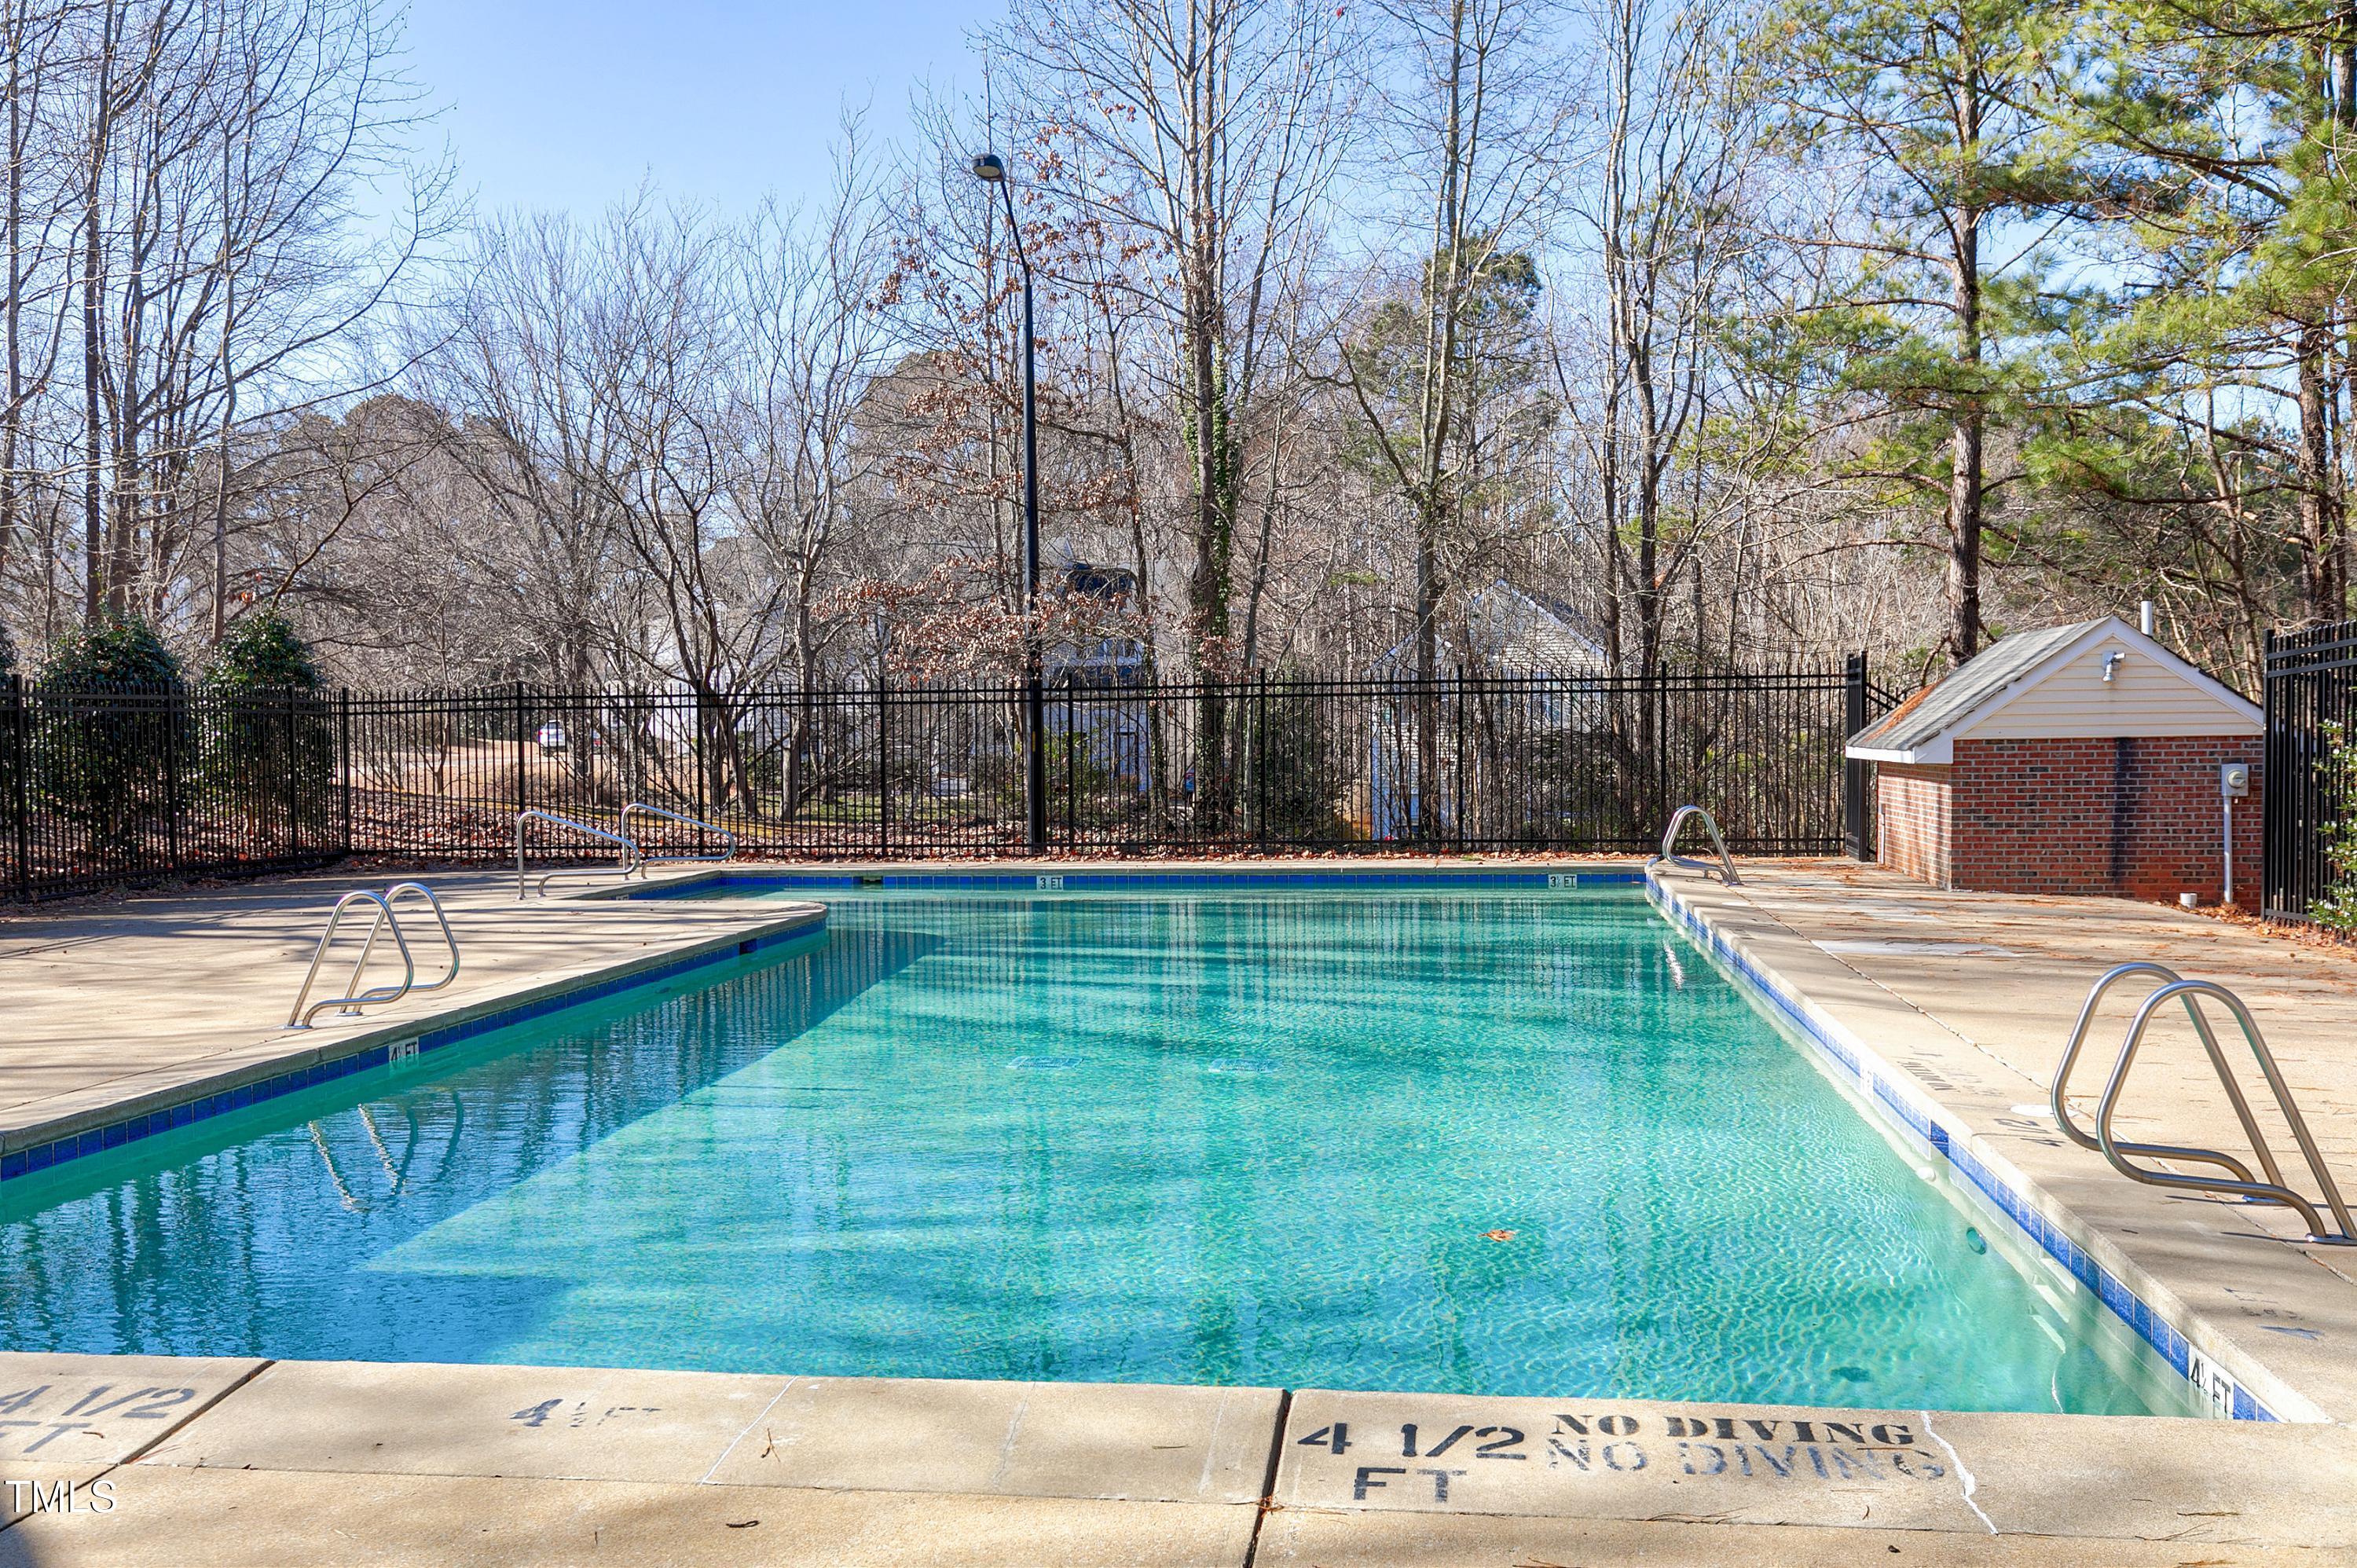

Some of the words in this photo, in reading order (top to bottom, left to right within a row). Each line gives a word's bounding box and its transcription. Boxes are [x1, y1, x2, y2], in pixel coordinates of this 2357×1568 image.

[61, 1383, 196, 1419] 1/2
[1297, 1423, 1352, 1455] 4
[1400, 1423, 1527, 1460] 1/2
[1550, 1414, 1640, 1436] NO
[1666, 1416, 1915, 1445] DIVING
[1547, 1438, 1648, 1472] NO
[1677, 1441, 1945, 1481] DIVING
[1353, 1467, 1468, 1503] FT
